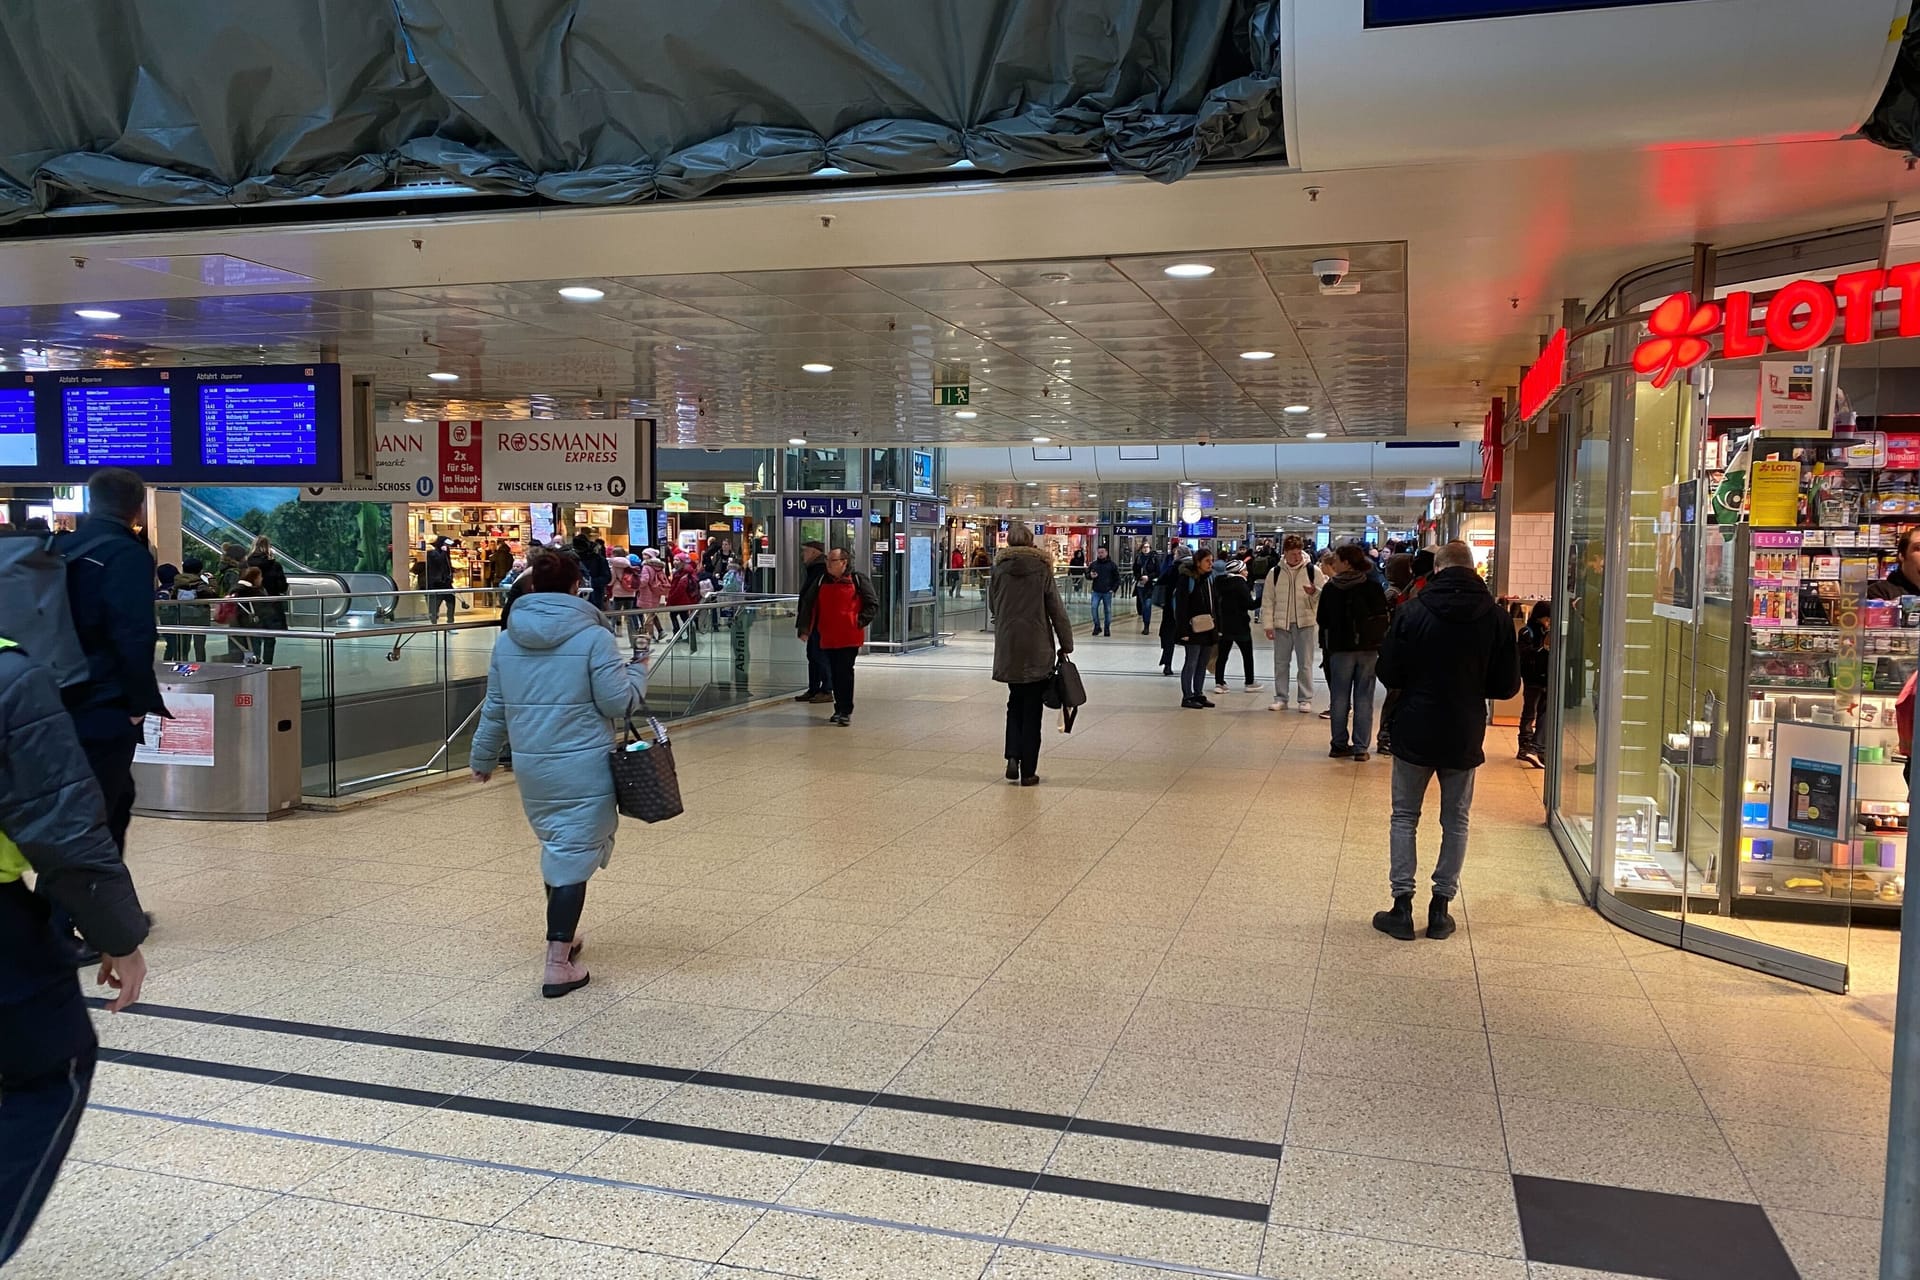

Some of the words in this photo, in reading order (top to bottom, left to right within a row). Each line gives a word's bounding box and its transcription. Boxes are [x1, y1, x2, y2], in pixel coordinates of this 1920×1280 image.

[498, 432, 618, 452] ROSSMANN
[454, 450, 467, 460] 2x
[565, 452, 618, 463] EXPRESS
[447, 463, 459, 472] für
[461, 463, 474, 472] Sie
[1771, 464, 1797, 472] LOTTO
[442, 474, 453, 483] im
[454, 474, 481, 484] Haupt-
[444, 484, 477, 494] bahnhof
[497, 482, 544, 492] ZWISCHEN
[546, 482, 572, 492] GLEIS
[786, 499, 807, 510] 9-10
[236, 695, 252, 706] DB
